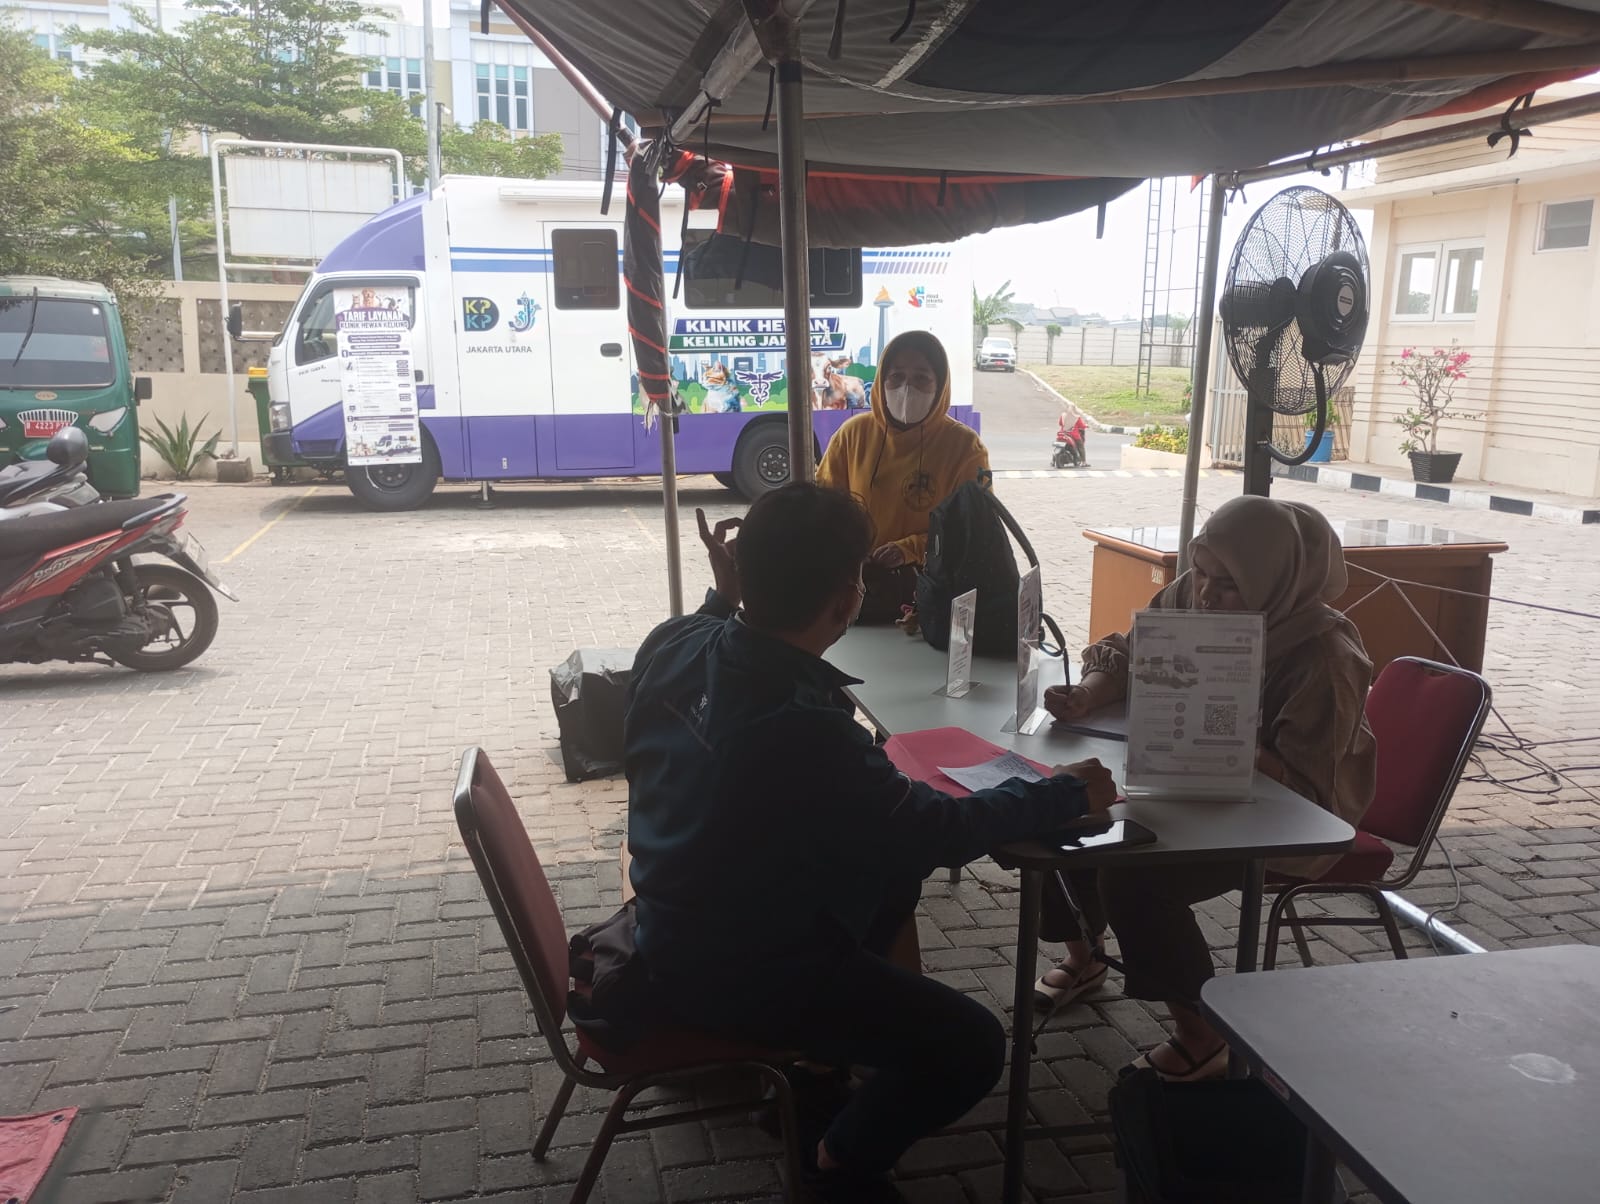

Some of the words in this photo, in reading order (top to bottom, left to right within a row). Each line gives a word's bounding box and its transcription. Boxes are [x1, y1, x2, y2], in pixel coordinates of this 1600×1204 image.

[343, 311, 366, 321] TARIF
[685, 319, 752, 333] KLINIK
[683, 335, 757, 347] KELILING
[466, 345, 503, 353] JAKARTA
[506, 345, 532, 353] UTARA
